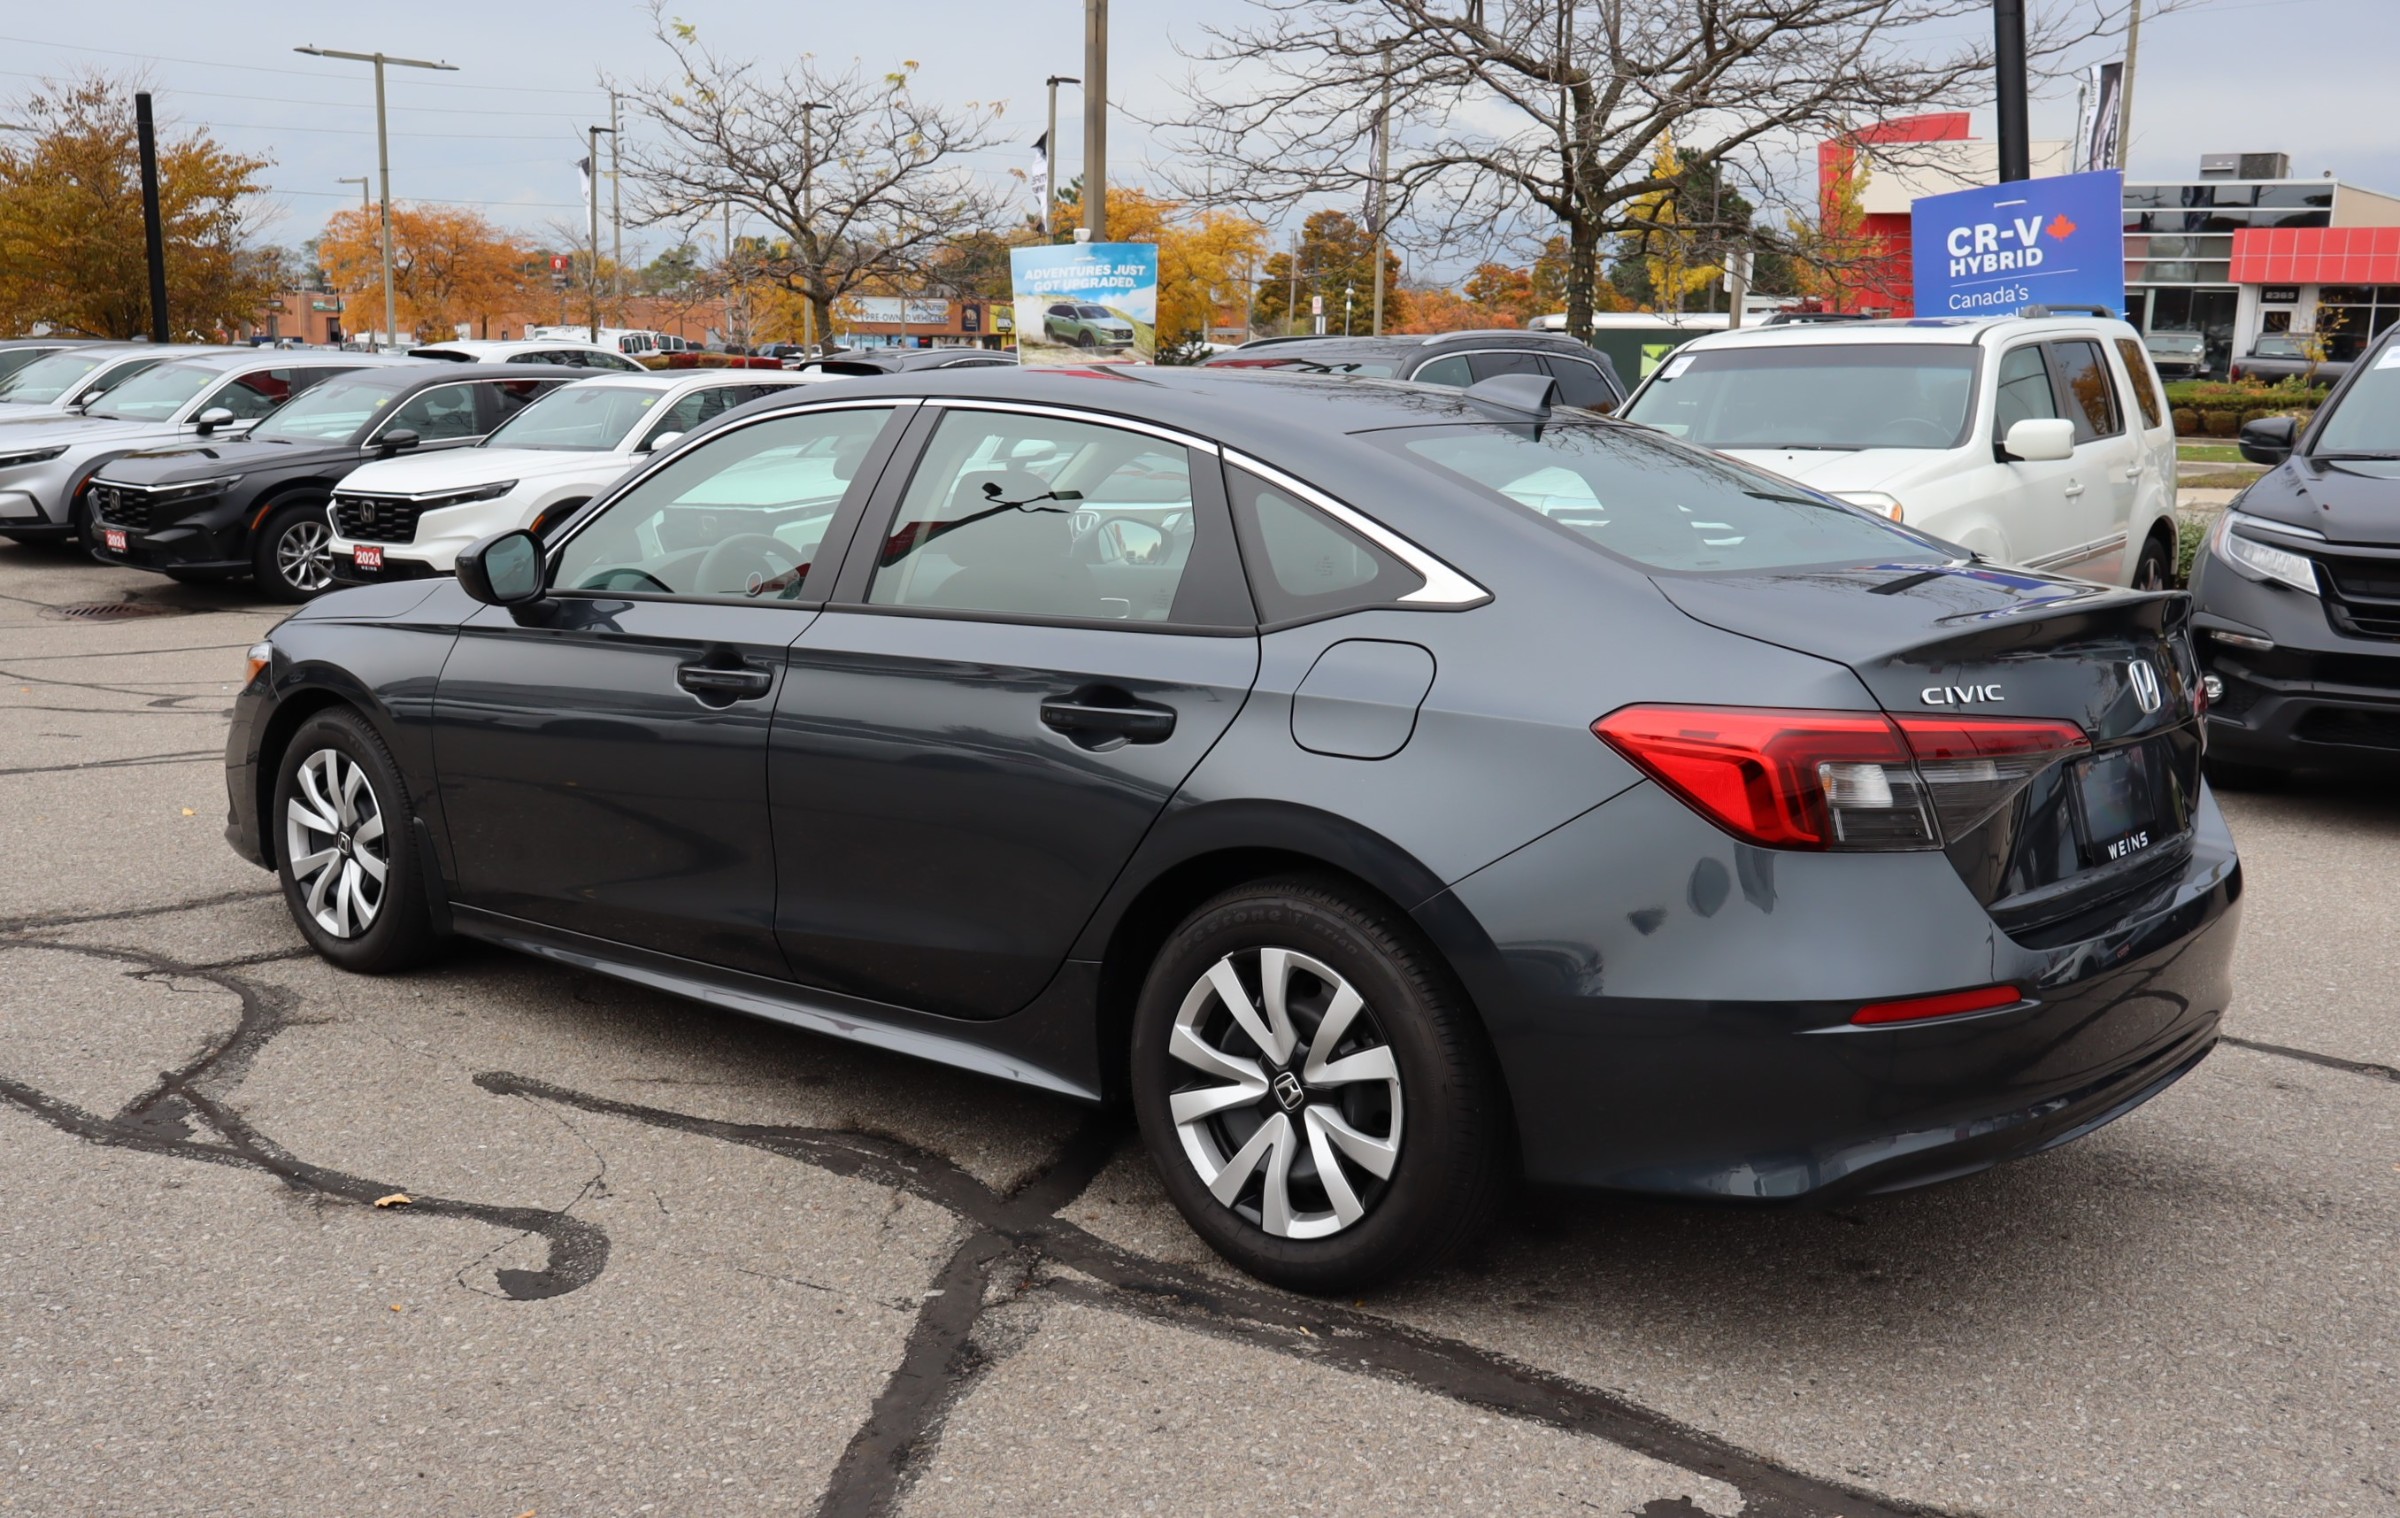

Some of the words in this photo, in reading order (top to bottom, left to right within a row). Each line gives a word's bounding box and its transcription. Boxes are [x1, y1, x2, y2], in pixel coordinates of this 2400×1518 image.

[1947, 215, 2043, 257] CR-V
[1950, 247, 2043, 278] HYBRID
[1024, 264, 1111, 280] ADVENTURES
[1113, 265, 1146, 276] JUST
[1034, 280, 1060, 292] GOT
[1063, 277, 1136, 290] UPGRADED.
[1949, 284, 2029, 310] Canada's
[865, 312, 910, 321] PRE-OWND
[107, 533, 126, 548] 2024
[356, 550, 381, 566] 2024
[1921, 684, 2005, 704] CIVIC
[2108, 831, 2148, 860] WEINS
